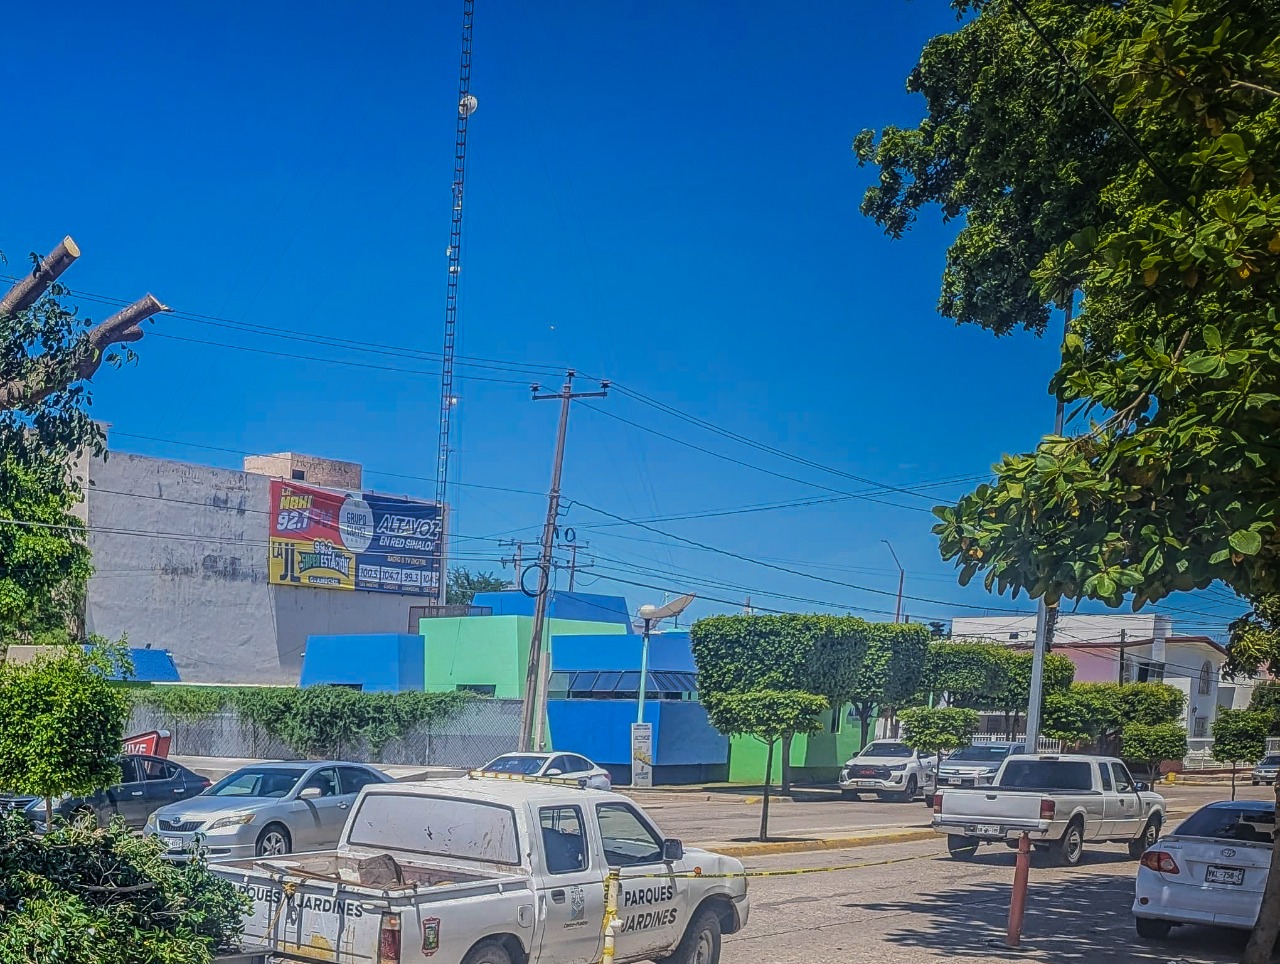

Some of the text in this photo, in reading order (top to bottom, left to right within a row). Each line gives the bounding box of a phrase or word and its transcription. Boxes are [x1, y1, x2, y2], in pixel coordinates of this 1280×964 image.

[276, 510, 310, 532] 92.1
[346, 511, 367, 525] GRUPO
[377, 514, 442, 539] ALTAVOZ
[379, 536, 390, 546] EN
[390, 537, 405, 548] RED
[404, 572, 419, 583] 99.3
[296, 892, 363, 918] JARDINES
[624, 885, 673, 907] PARQUES
[621, 907, 678, 933] JARDINES
